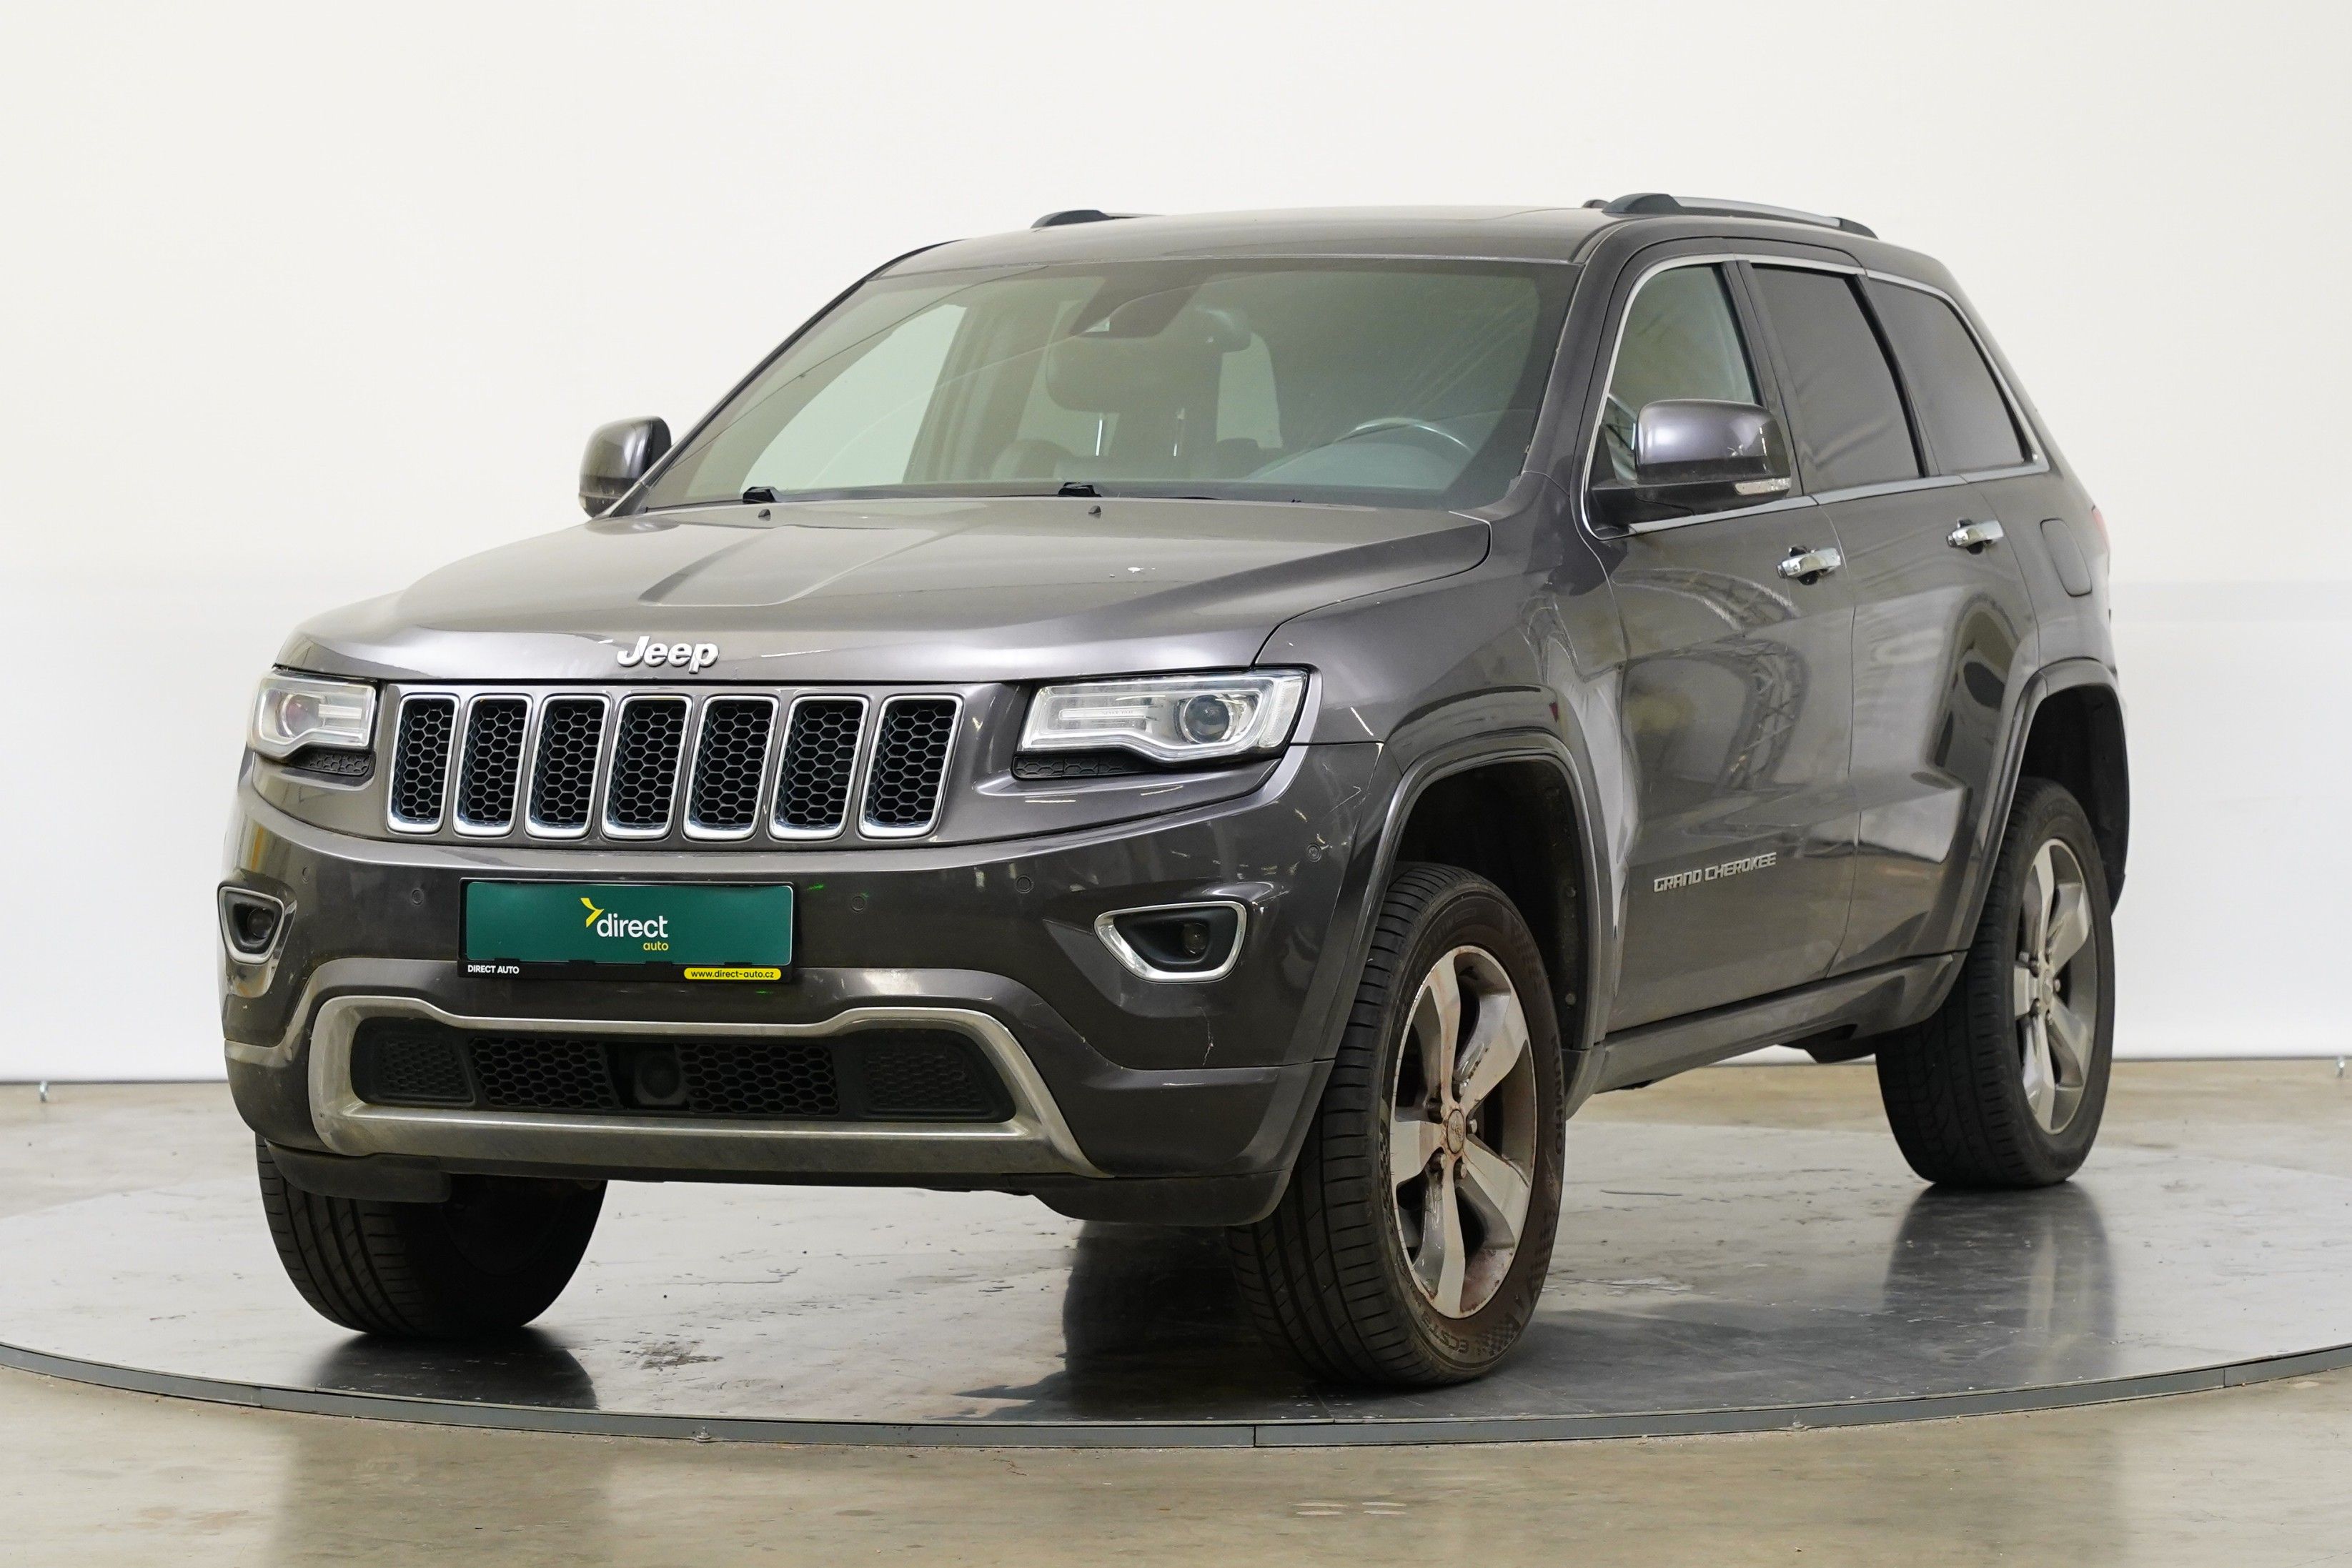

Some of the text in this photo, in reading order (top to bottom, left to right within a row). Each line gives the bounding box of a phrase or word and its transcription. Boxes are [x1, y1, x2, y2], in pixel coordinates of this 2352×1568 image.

[617, 635, 719, 674] Jeep
[1654, 852, 1777, 892] GRAND CHEROKEE
[596, 913, 668, 938] direct
[642, 941, 669, 951] auto
[467, 964, 520, 974] DIRECT AUTO
[690, 970, 775, 978] www.direct-auto.cz
